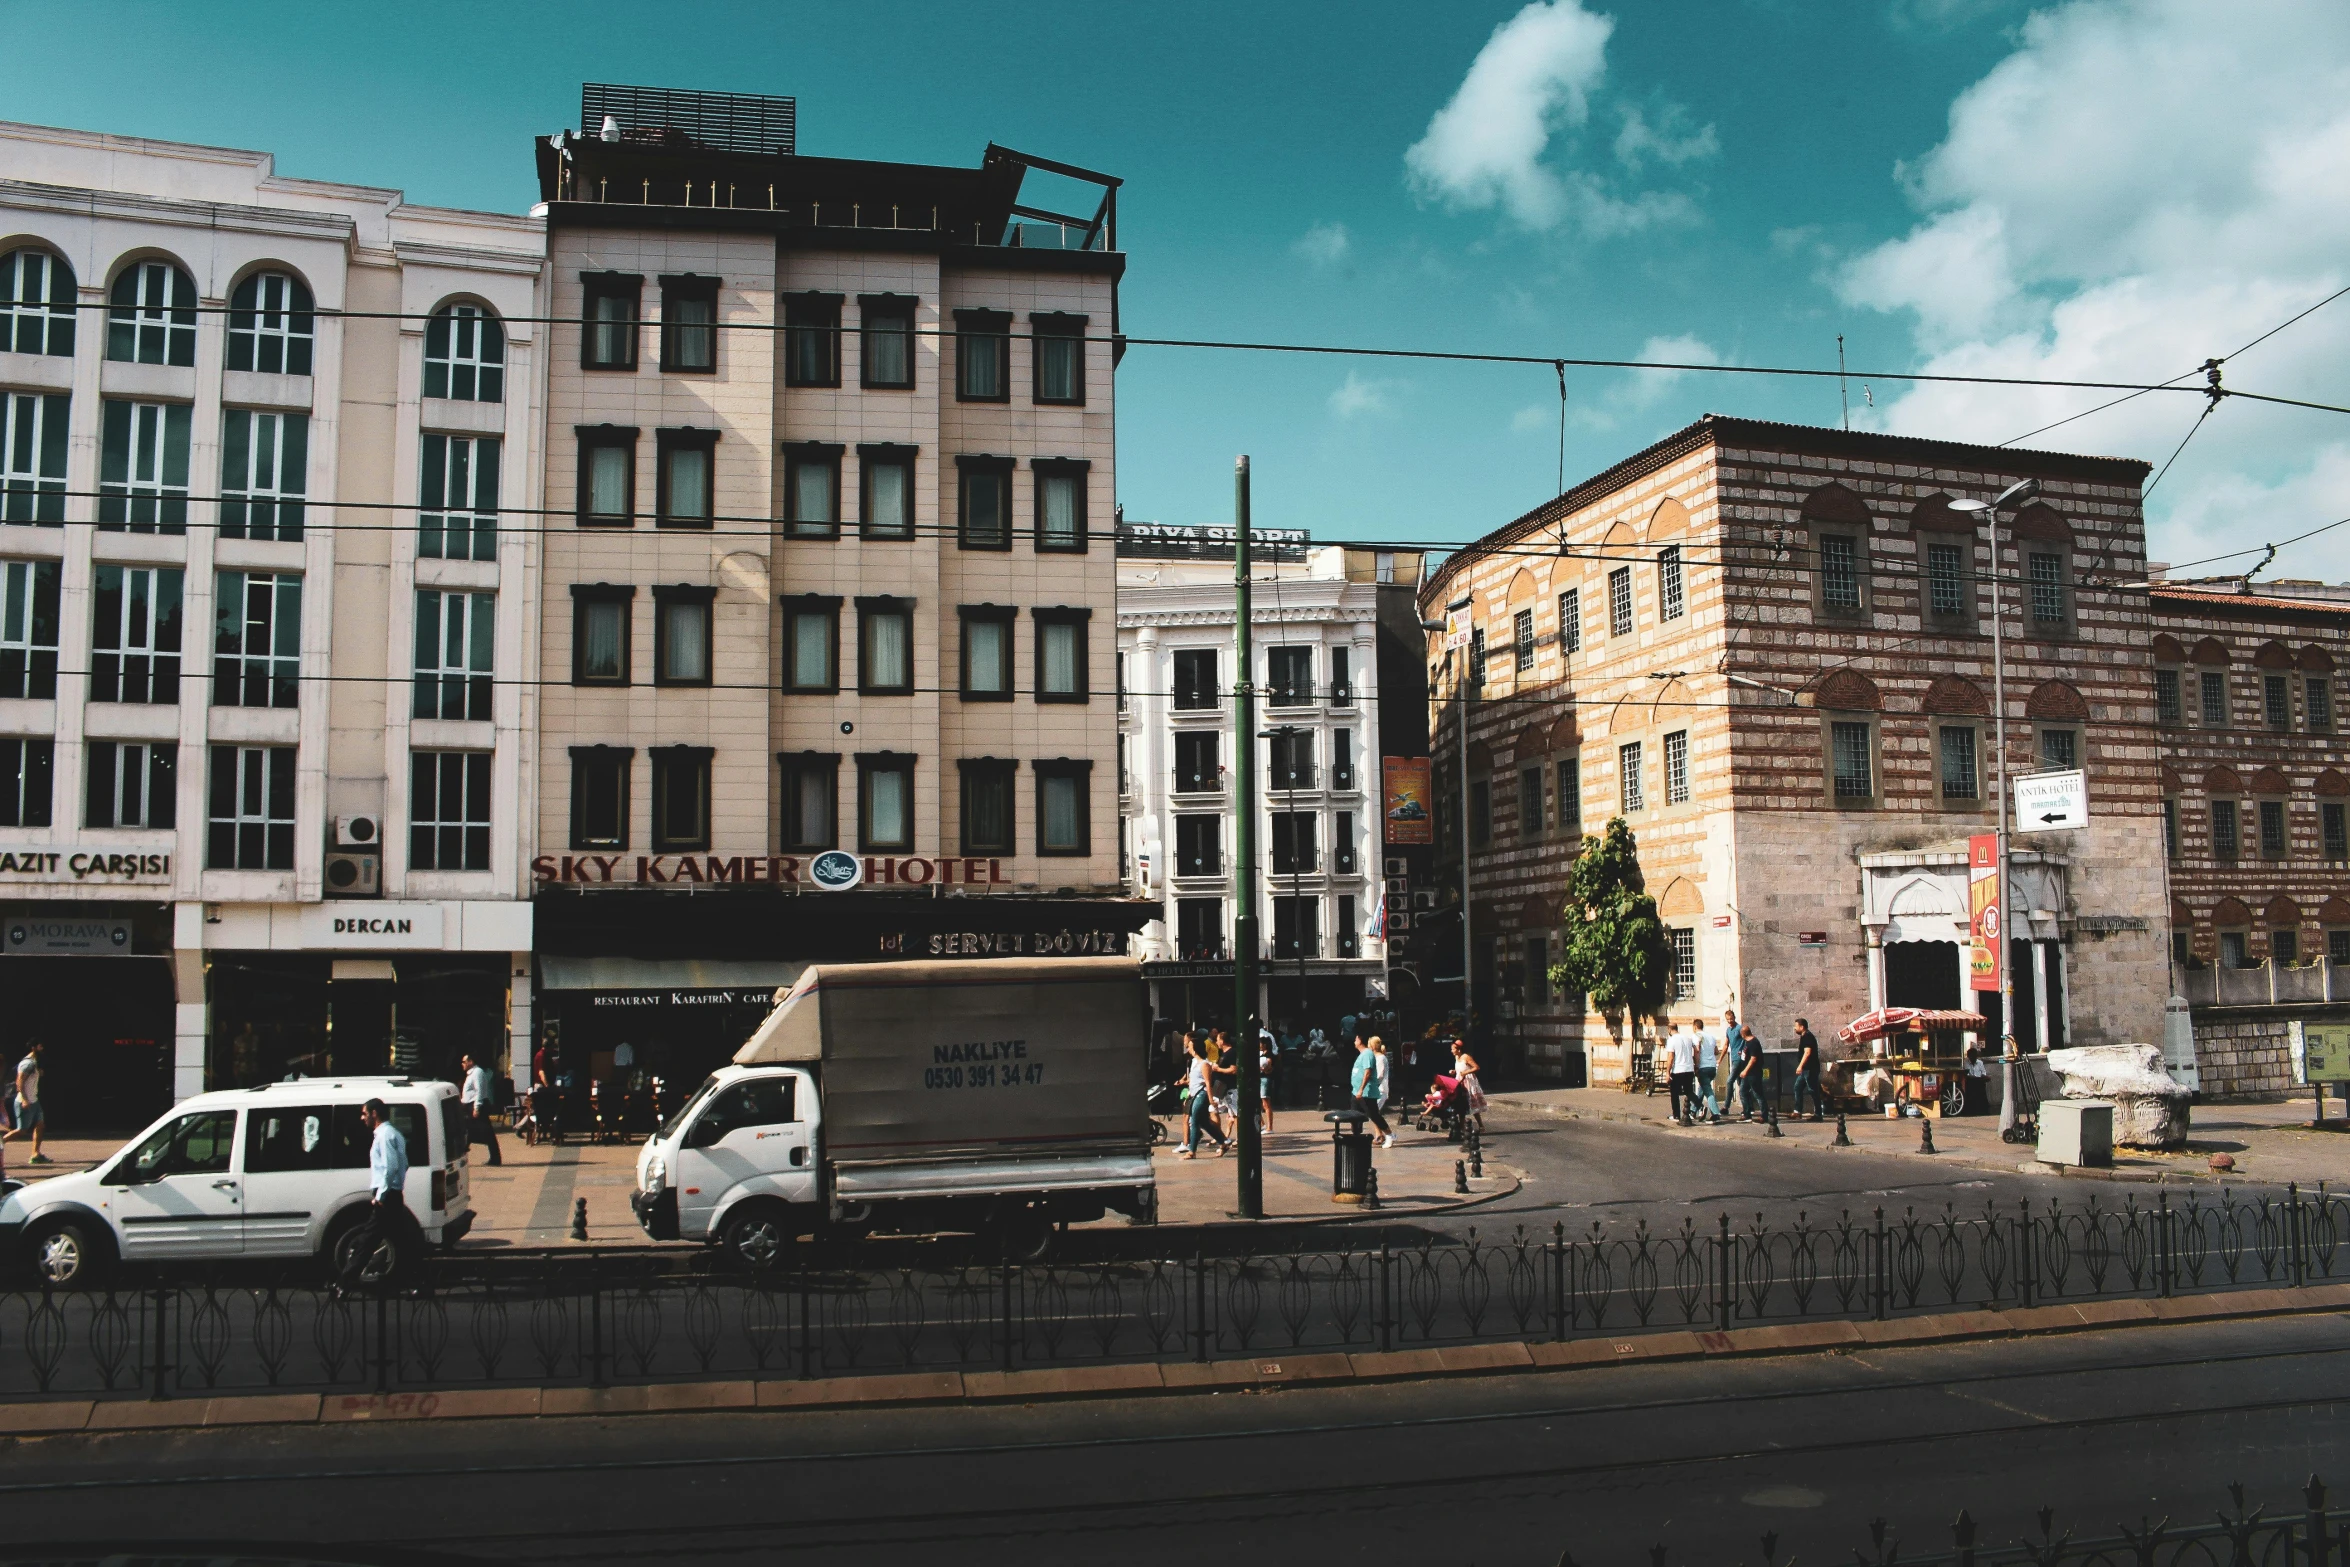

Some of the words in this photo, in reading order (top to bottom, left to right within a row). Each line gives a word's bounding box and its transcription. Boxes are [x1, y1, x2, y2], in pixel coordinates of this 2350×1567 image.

[2049, 783, 2081, 794] HOTEL
[0, 852, 61, 873] AZIT
[68, 853, 169, 880] ÇARŞISI
[531, 855, 622, 883] SKY
[636, 855, 800, 883] KAMER
[864, 857, 1012, 885] HOTEL
[30, 924, 108, 938] MORAVA
[334, 919, 411, 933] DERCAN
[929, 932, 1026, 954] SERVET
[1034, 928, 1117, 954] DÖVİZ
[1158, 966, 1192, 975] HOTEL
[594, 995, 660, 1006] RESTAURANT
[743, 994, 769, 1004] CAFE
[924, 1066, 963, 1090] 0530
[968, 1065, 995, 1088] 391
[1001, 1064, 1021, 1086] 34
[1025, 1063, 1044, 1085] 47
